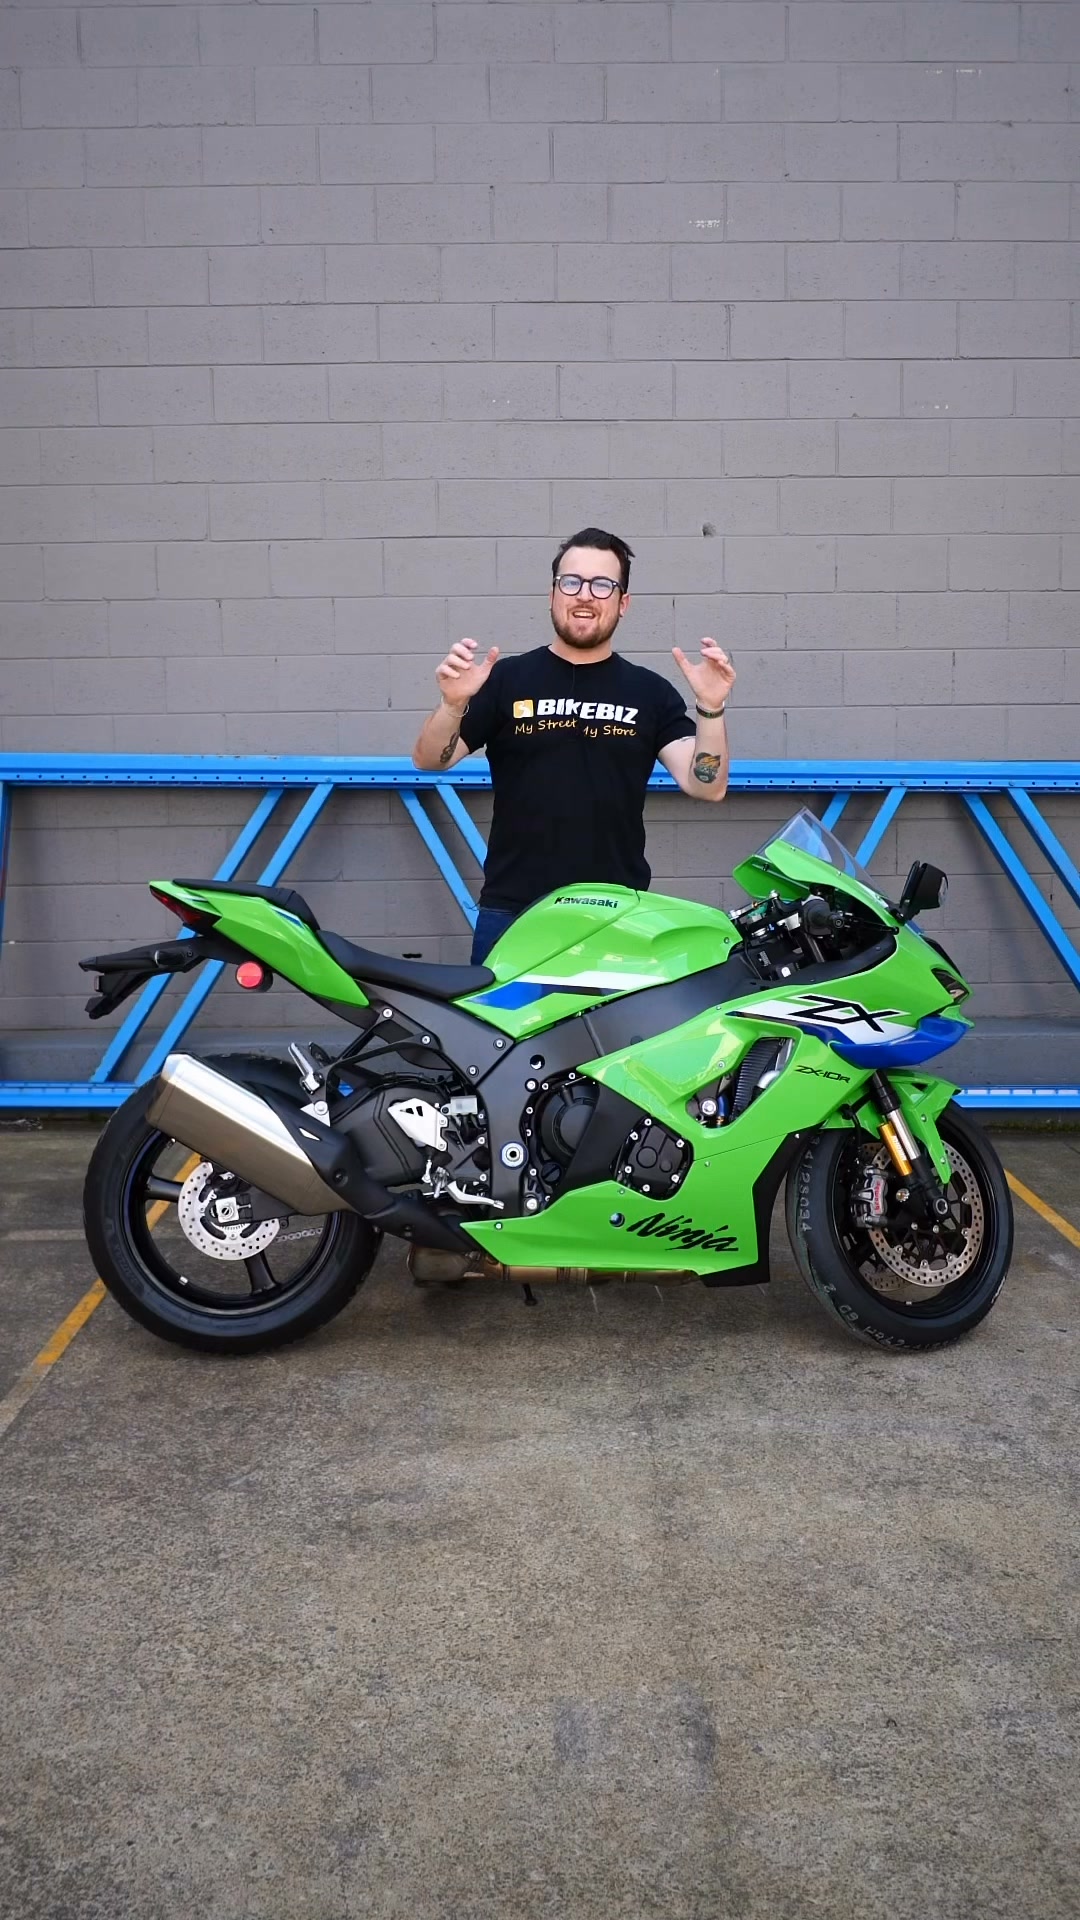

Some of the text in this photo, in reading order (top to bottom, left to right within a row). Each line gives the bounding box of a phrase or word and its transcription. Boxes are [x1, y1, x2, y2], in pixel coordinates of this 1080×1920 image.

[536, 698, 639, 725] BIKEBIZ
[514, 722, 533, 735] My
[537, 718, 578, 731] Street
[603, 725, 637, 737] Store
[554, 896, 619, 909] Kawasaki
[786, 994, 901, 1034] ZX
[794, 1065, 851, 1084] ZX-10R
[626, 1212, 739, 1252] Ninja
